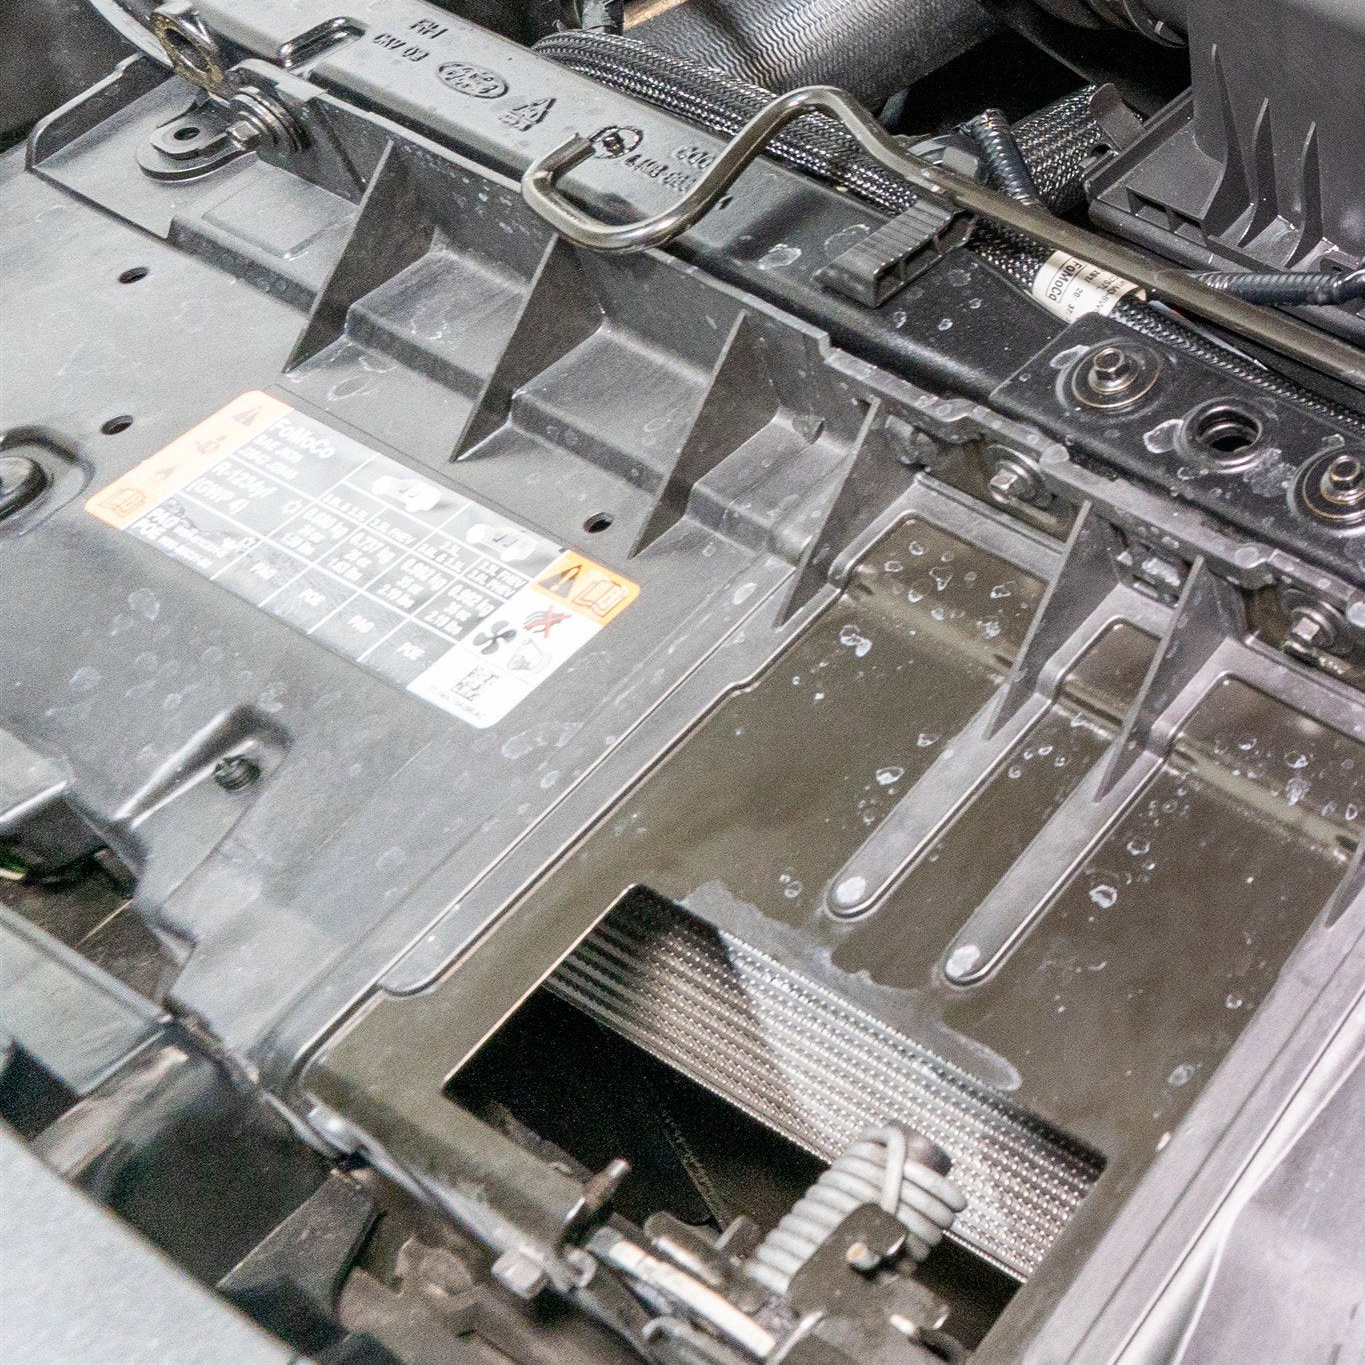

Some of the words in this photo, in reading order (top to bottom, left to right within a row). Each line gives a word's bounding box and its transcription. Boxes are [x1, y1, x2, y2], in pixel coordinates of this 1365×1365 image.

[1048, 259, 1082, 301] FoMoCo
[269, 417, 334, 457] FoMoCo
[212, 461, 275, 497] R-1234yf
[147, 508, 179, 528] PAG
[132, 518, 165, 539] POE
[376, 546, 394, 564] kg
[428, 573, 446, 590] kg
[475, 599, 494, 616] kg
